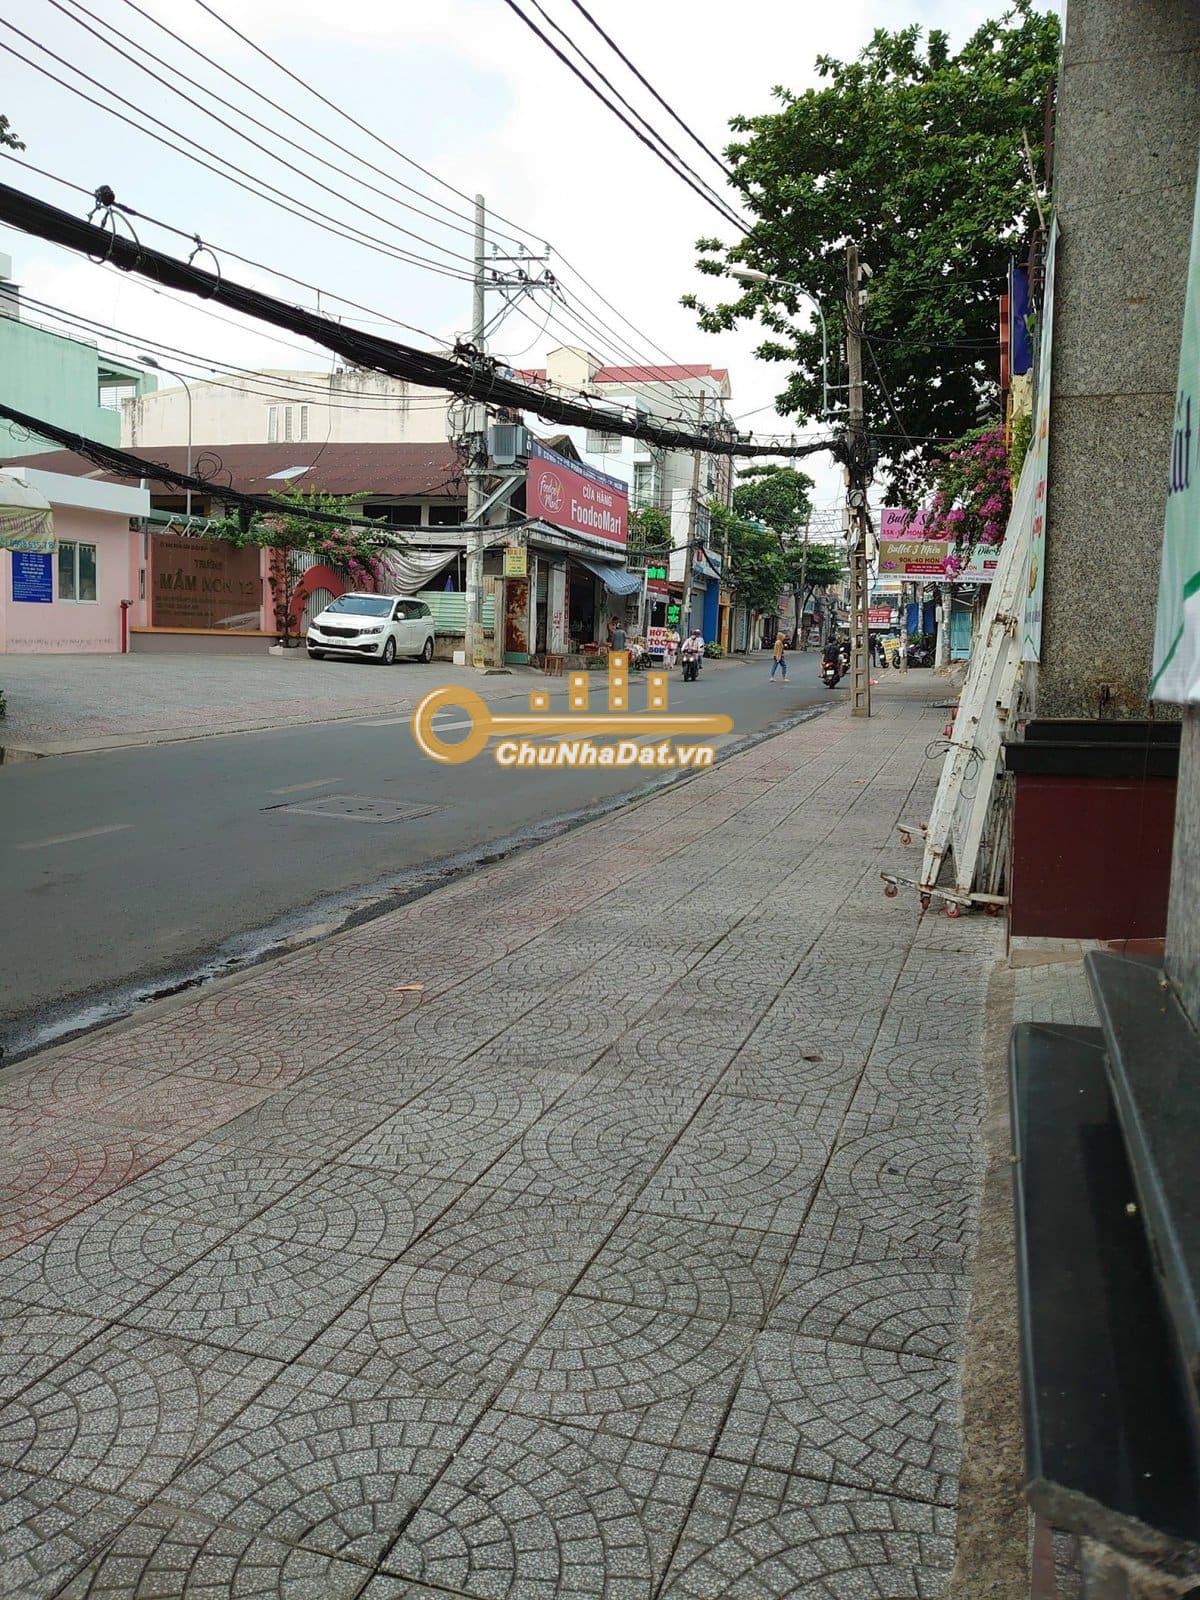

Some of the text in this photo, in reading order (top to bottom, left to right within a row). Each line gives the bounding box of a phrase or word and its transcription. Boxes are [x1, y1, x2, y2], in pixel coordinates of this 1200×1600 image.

[582, 484, 595, 501] CỬA
[571, 499, 622, 535] FoodcoMart
[159, 568, 197, 591] MẦM
